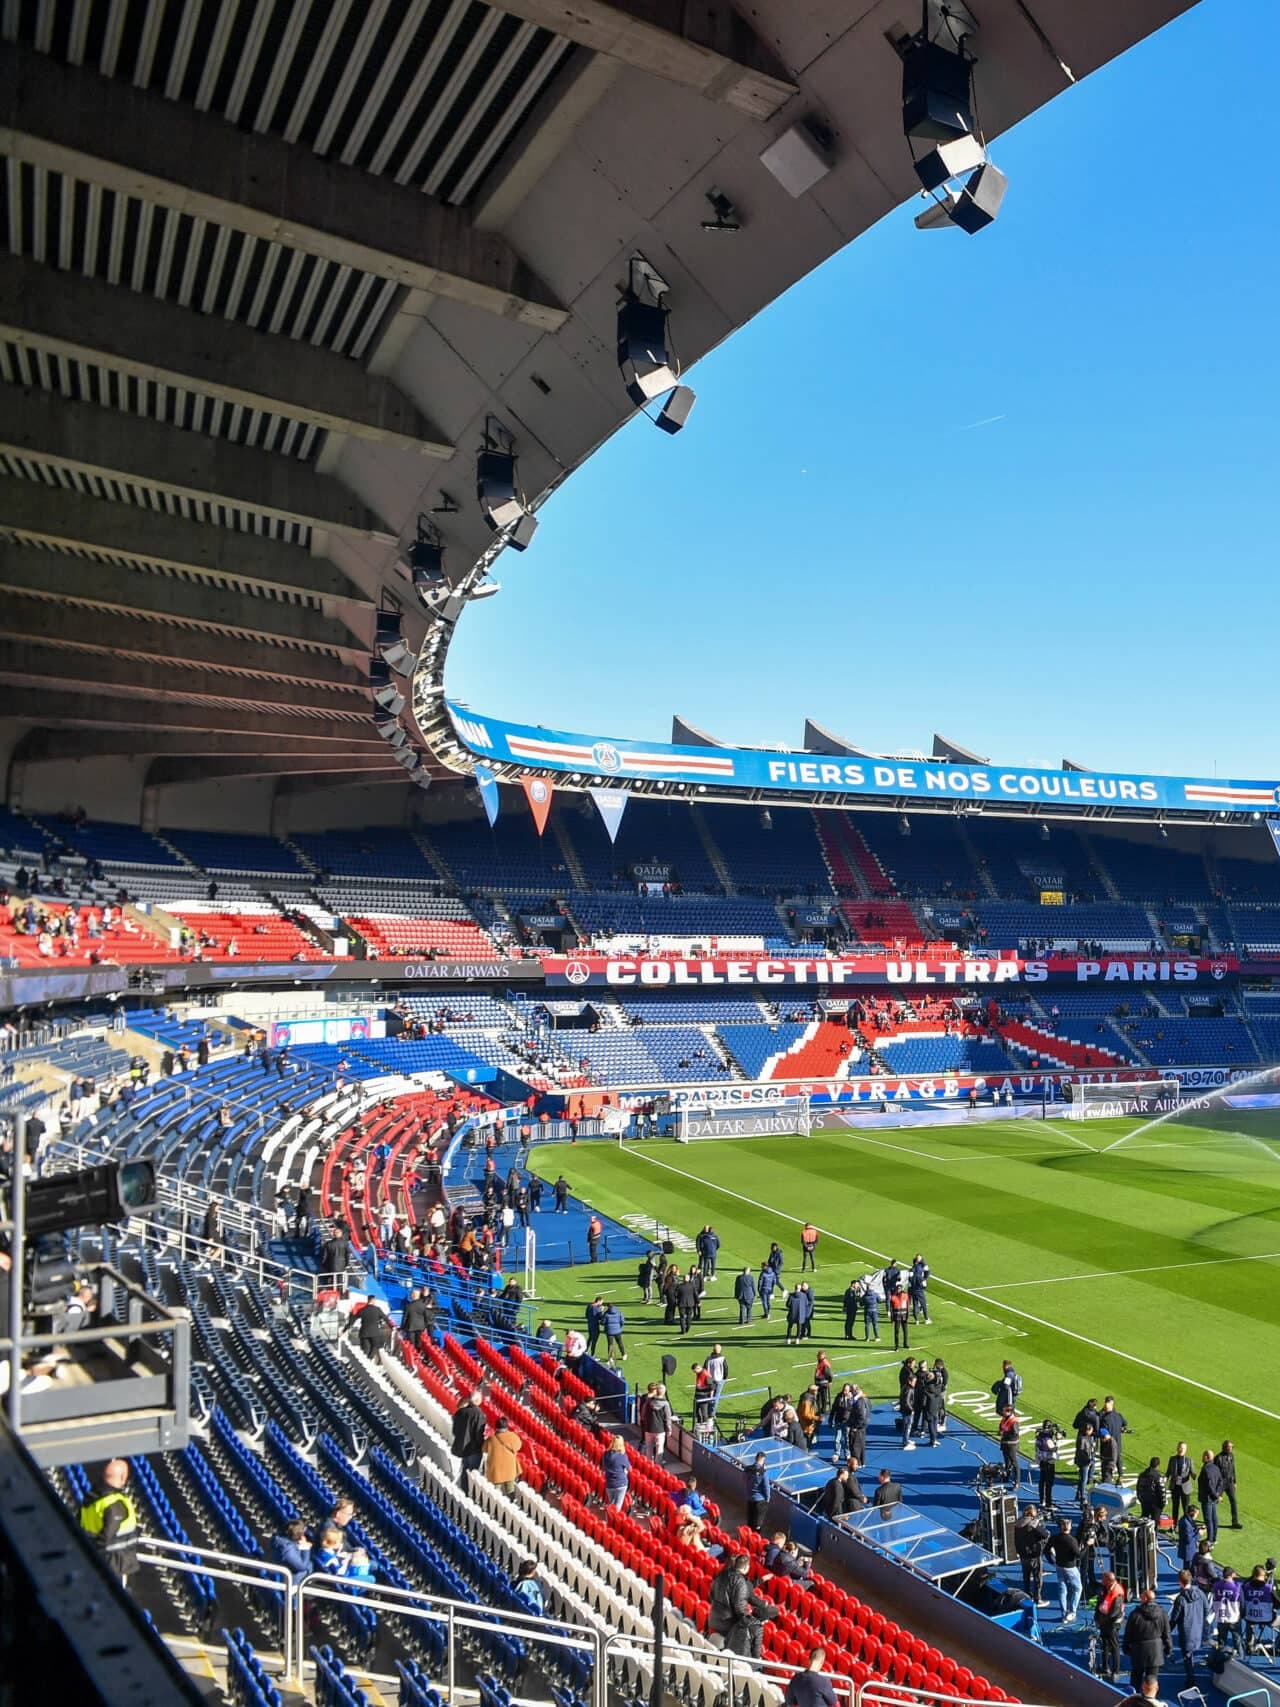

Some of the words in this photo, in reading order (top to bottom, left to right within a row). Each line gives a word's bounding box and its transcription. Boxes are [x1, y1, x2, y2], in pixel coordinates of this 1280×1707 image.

[769, 760, 865, 786] FIERS
[874, 765, 916, 789] DE
[926, 769, 991, 793] NOS
[998, 773, 1158, 802] COULEURS
[634, 867, 668, 875] QATAR
[1034, 876, 1063, 884] QATAR
[404, 965, 451, 979] QATAR
[452, 964, 510, 978] AIRWAYS
[606, 961, 856, 984] COLLECTIF
[886, 961, 1049, 984] ULTRAS
[1077, 961, 1199, 981] PARIS
[1181, 1071, 1225, 1085] 1970
[826, 1079, 960, 1102] VIRAGE
[1153, 1097, 1210, 1112] AIRWAYS
[688, 1119, 745, 1136] QATAR
[752, 1115, 825, 1132] AIRWAYS
[1217, 1589, 1233, 1597] LFP
